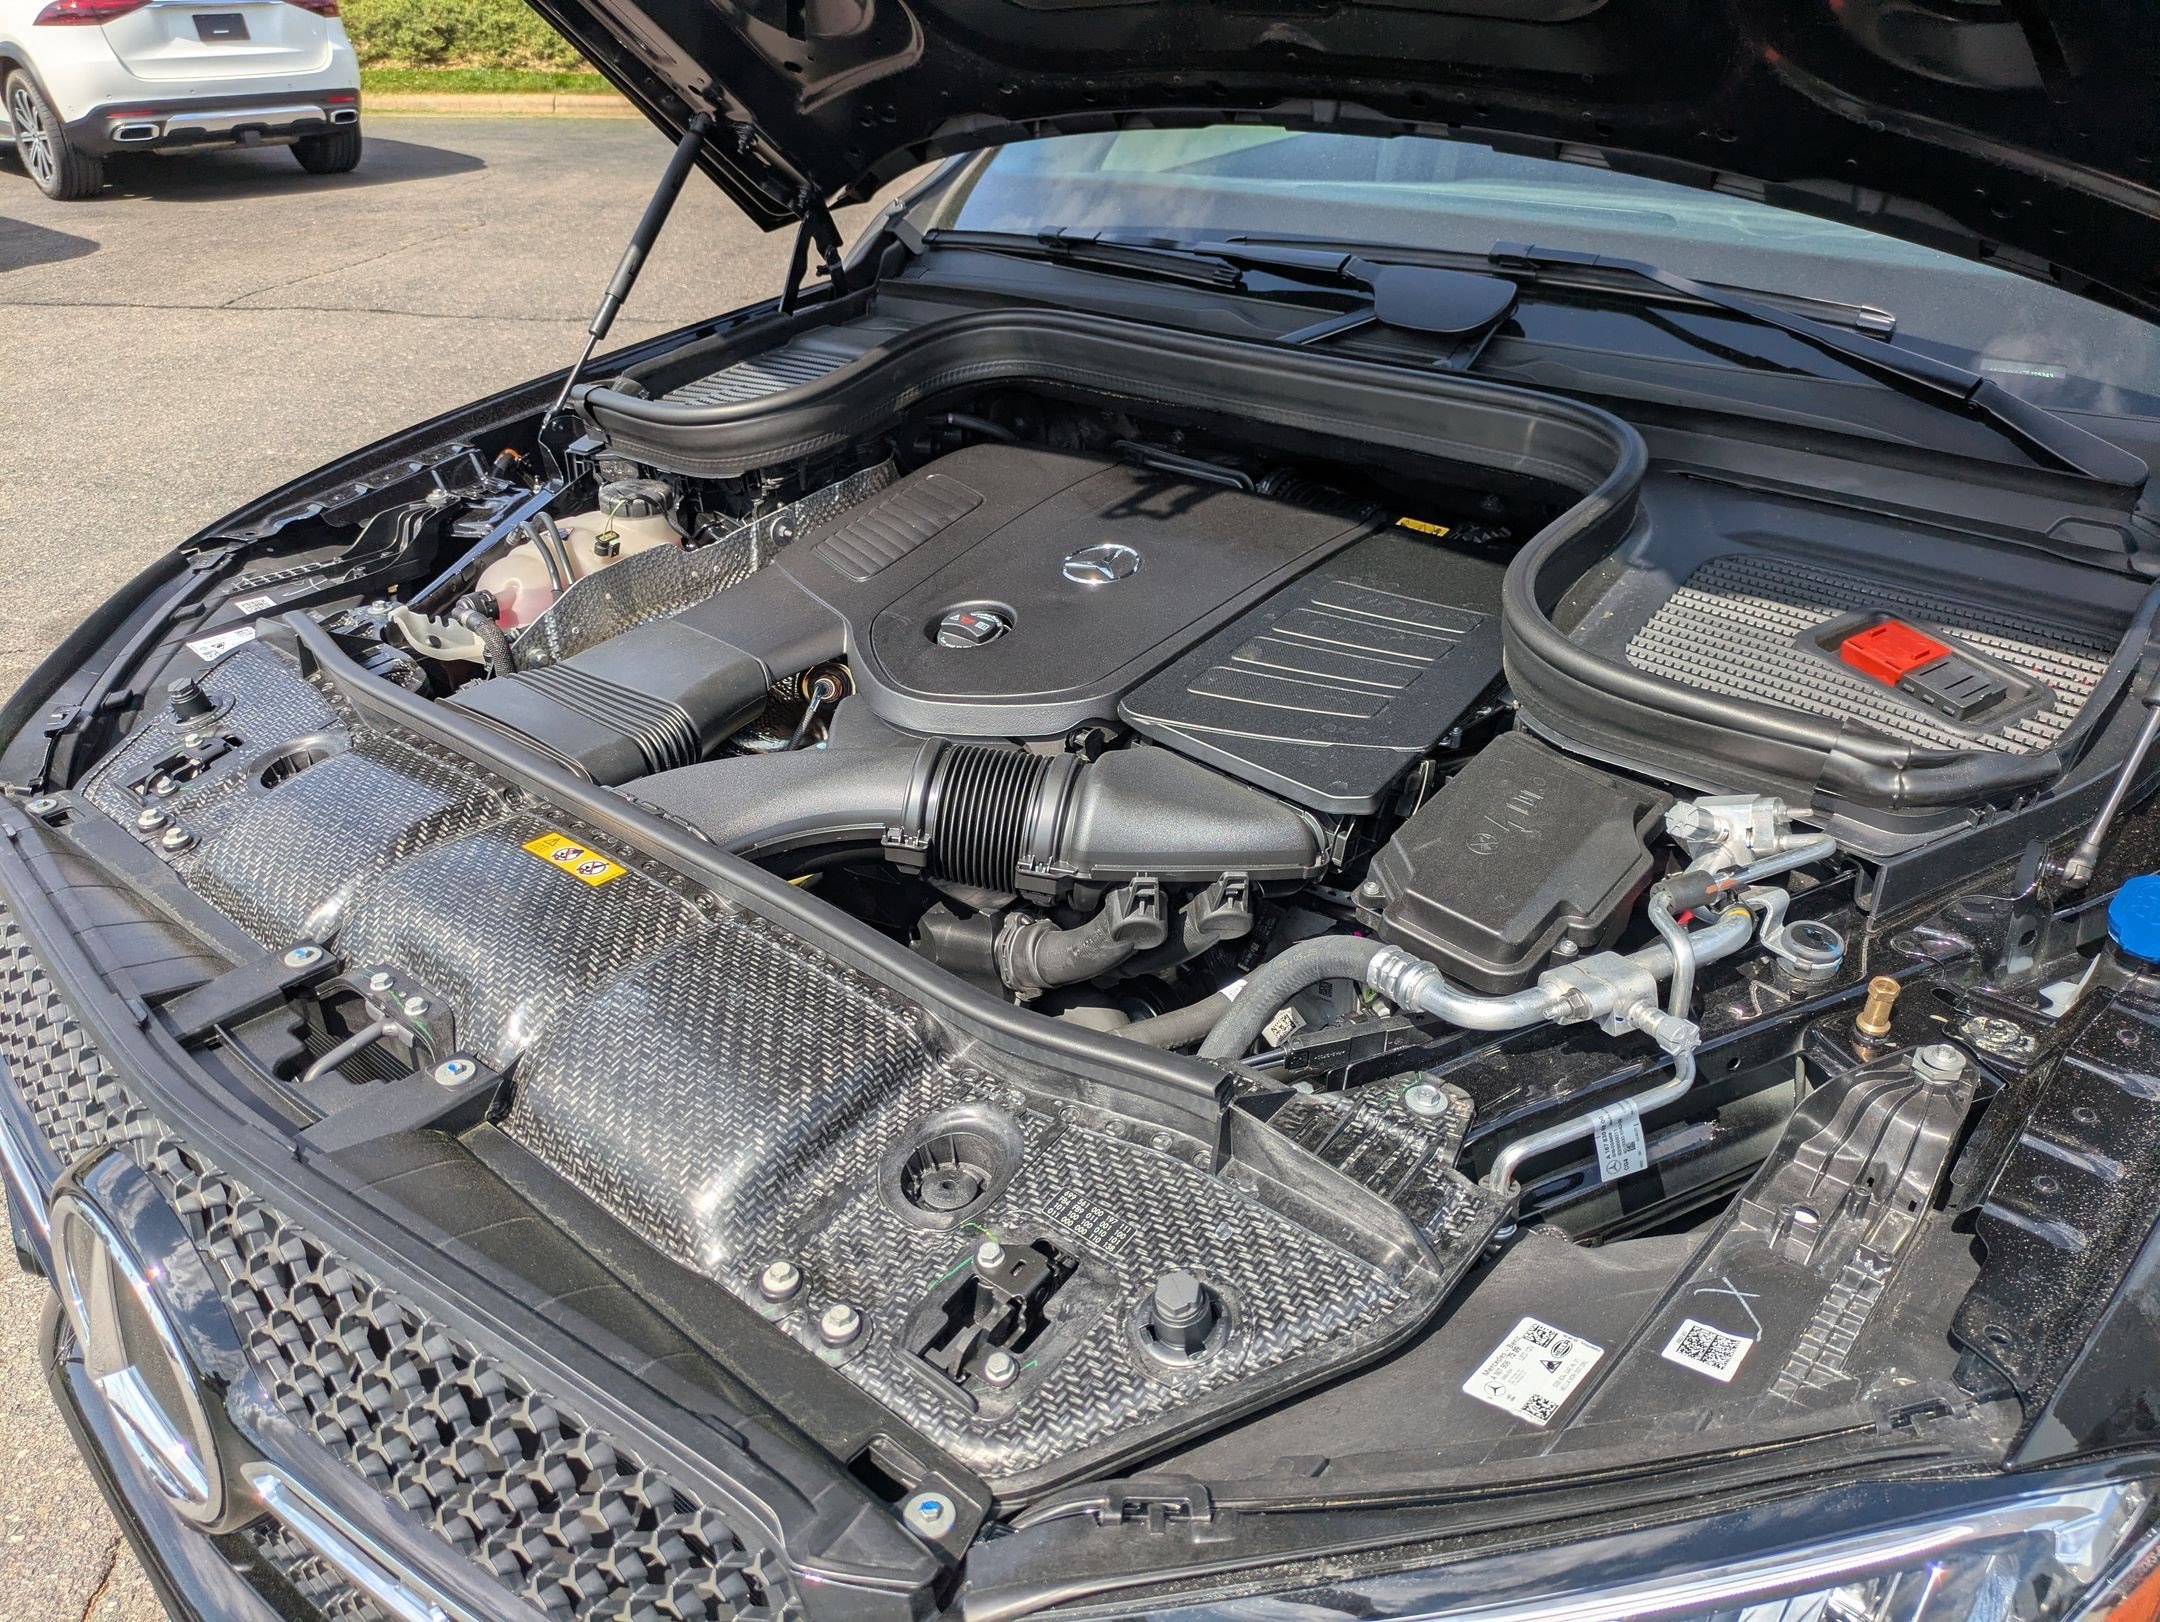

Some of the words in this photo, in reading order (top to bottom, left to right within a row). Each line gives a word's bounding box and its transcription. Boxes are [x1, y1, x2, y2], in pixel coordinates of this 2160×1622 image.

[1047, 1208, 1060, 1218] 011
[1060, 1216, 1074, 1227] 000
[1074, 1225, 1088, 1235] 000
[1089, 1233, 1102, 1244] 110
[1053, 1202, 1066, 1212] 101
[1067, 1210, 1080, 1221] 100
[1081, 1218, 1093, 1229] 100
[1093, 1227, 1107, 1238] 010
[1108, 1235, 1121, 1245] 101
[1063, 1190, 1077, 1200] 699
[1077, 1198, 1090, 1209] 561
[1090, 1206, 1104, 1217] 000
[1105, 1215, 1119, 1225] 197
[1119, 1224, 1132, 1233] 111
[1085, 1212, 1099, 1223] 011
[1099, 1221, 1113, 1231] 001
[1114, 1229, 1127, 1240] 100
[1481, 1351, 1507, 1377] Mercedes
[1506, 1335, 1522, 1349] Benz
